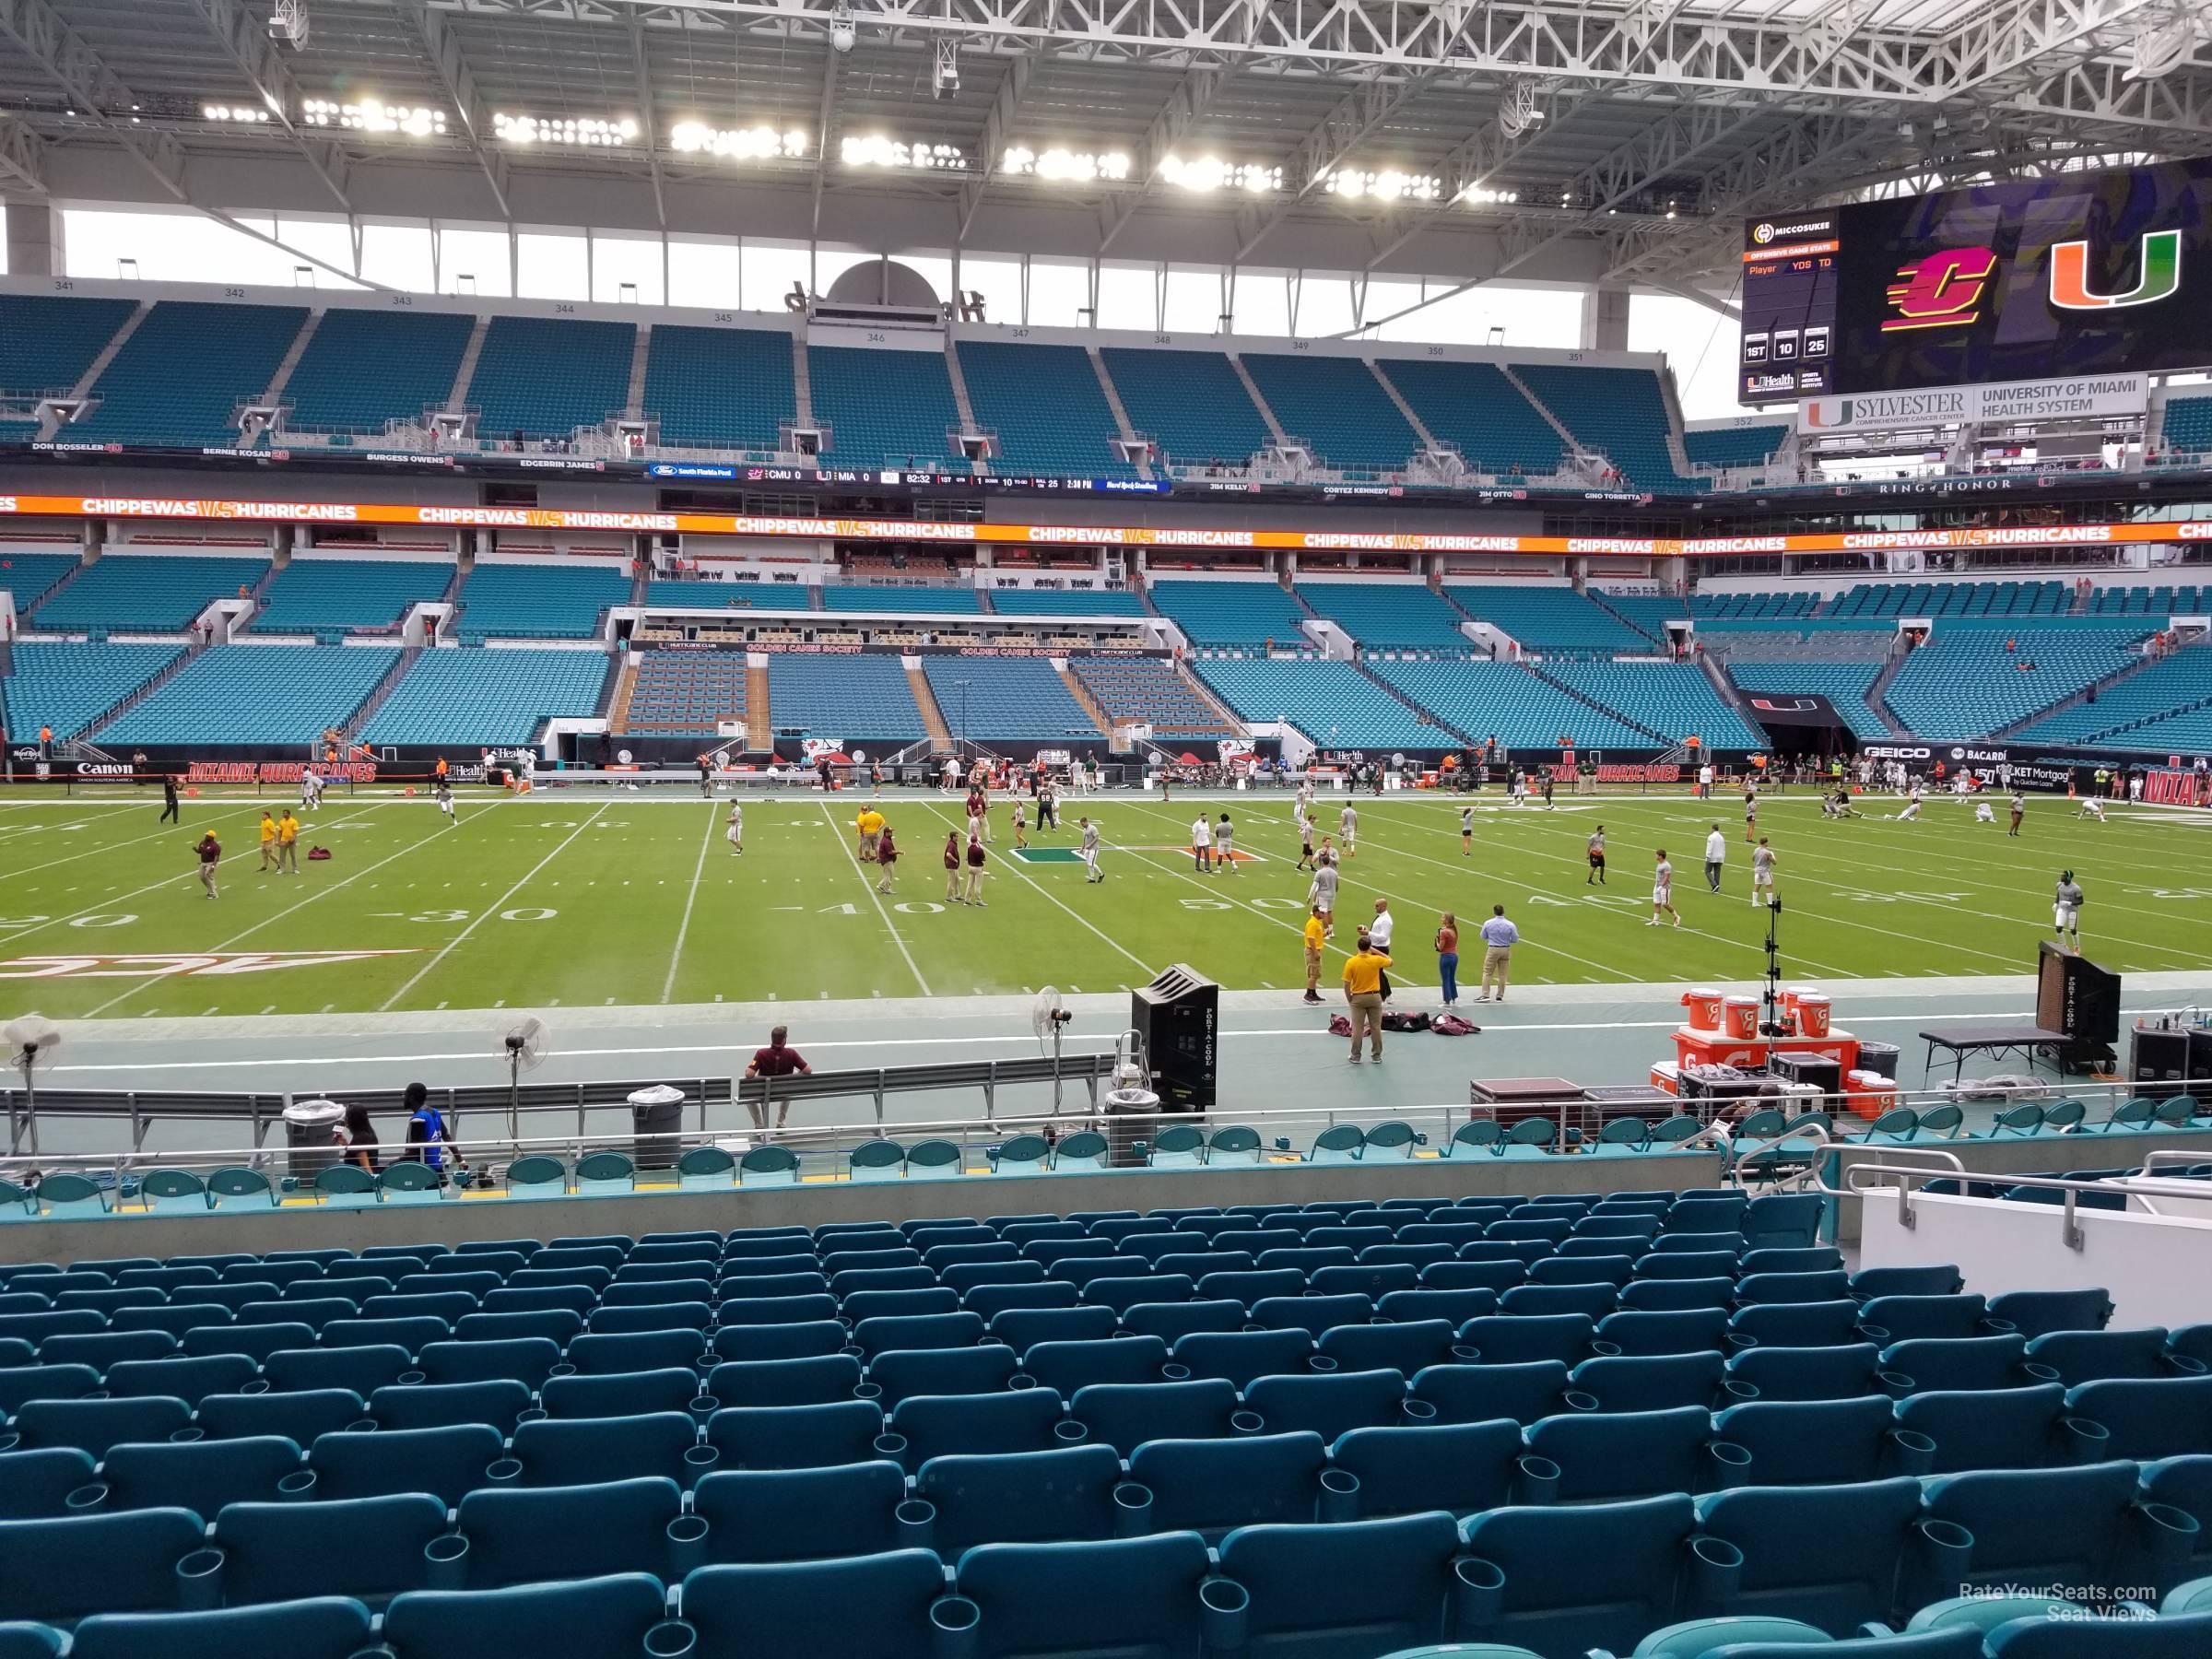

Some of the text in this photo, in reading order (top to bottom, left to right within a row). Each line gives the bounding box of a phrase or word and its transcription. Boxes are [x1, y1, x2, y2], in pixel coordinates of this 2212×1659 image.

[1775, 221, 1830, 236] MICCOSUKEE
[1751, 243, 1831, 259] OFFENSIVE GAME STATS
[1749, 258, 1831, 275] Player YDS TD
[55, 281, 74, 290] 341
[225, 288, 244, 298] 342
[393, 296, 412, 306] 343
[556, 304, 575, 314] 344
[714, 313, 733, 323] 345
[867, 333, 885, 343] 346
[1012, 328, 1030, 338] 347
[1154, 335, 1171, 345] 348
[1292, 340, 1309, 350] 349
[1779, 344, 1793, 354] 10
[1808, 340, 1825, 352] 25
[1427, 347, 1443, 357] 350
[1568, 352, 1583, 362] 351
[1747, 347, 1765, 357] 1ST
[1983, 379, 2136, 402] UNIVERSITY OF MIAMI
[1855, 393, 1964, 418] SYLVESTER
[1982, 398, 2093, 418] HEALTH SYSTEM
[1734, 417, 1753, 427] 352
[1855, 418, 1909, 426] COMPREHENSIVE
[56, 443, 104, 452] BOSSELER
[203, 448, 237, 456] BERNIE
[239, 450, 272, 458] KOSAR
[367, 453, 408, 463] BURGESS
[410, 455, 444, 464] OWENS
[520, 459, 565, 468] EDGERRIN
[566, 461, 595, 469] JAMES
[697, 468, 717, 477] Florida
[718, 469, 732, 477] Ford
[769, 470, 801, 480] CMU 0
[838, 472, 855, 481] MIA
[863, 473, 869, 482] 0
[906, 474, 930, 484] 82:32
[1003, 477, 1013, 487] 10
[1048, 479, 1058, 488] 25
[1082, 479, 1092, 489] PM
[1106, 481, 1158, 490] Hard Rock Stadium
[1209, 483, 1223, 491] JIM
[1225, 484, 1248, 492] KELLY
[1879, 484, 1925, 494] RING
[1943, 479, 2011, 492] HONOR
[1493, 490, 1512, 499] OTTO
[1605, 493, 1641, 501] TORRETTA
[82, 499, 197, 516] CHIPPEWAS
[237, 502, 357, 520] HURRICANES
[418, 508, 527, 525] CHIPPEWAS
[564, 512, 677, 529] HURRICANES
[735, 517, 836, 534] CHIPPEWAS
[871, 522, 975, 539] HURRICANES
[1029, 526, 1123, 543] CHIPPEWAS
[1154, 530, 1253, 546] HURRICANES
[1843, 529, 1949, 548] CHIPPEWAS
[1987, 526, 2111, 544] HURRICANES
[1303, 533, 1394, 548] CHIPPEWAS
[1425, 536, 1519, 551] HURRICANES
[1567, 538, 1653, 553] CHIPPEWAS
[1683, 537, 1786, 553] HURRICANES
[746, 643, 863, 653] GOLDEN CANES SOCIETY
[960, 648, 1071, 657] GOLDEN CANES SOCIETY
[1865, 747, 1931, 759] GEICO
[77, 762, 134, 774] Canon
[188, 762, 257, 782] MIAMI
[2033, 769, 2069, 782] Mortgag
[1710, 1003, 1719, 1014] G
[1818, 1008, 1827, 1019] G
[1745, 1010, 1754, 1021] G
[1880, 1094, 1890, 1105] G
